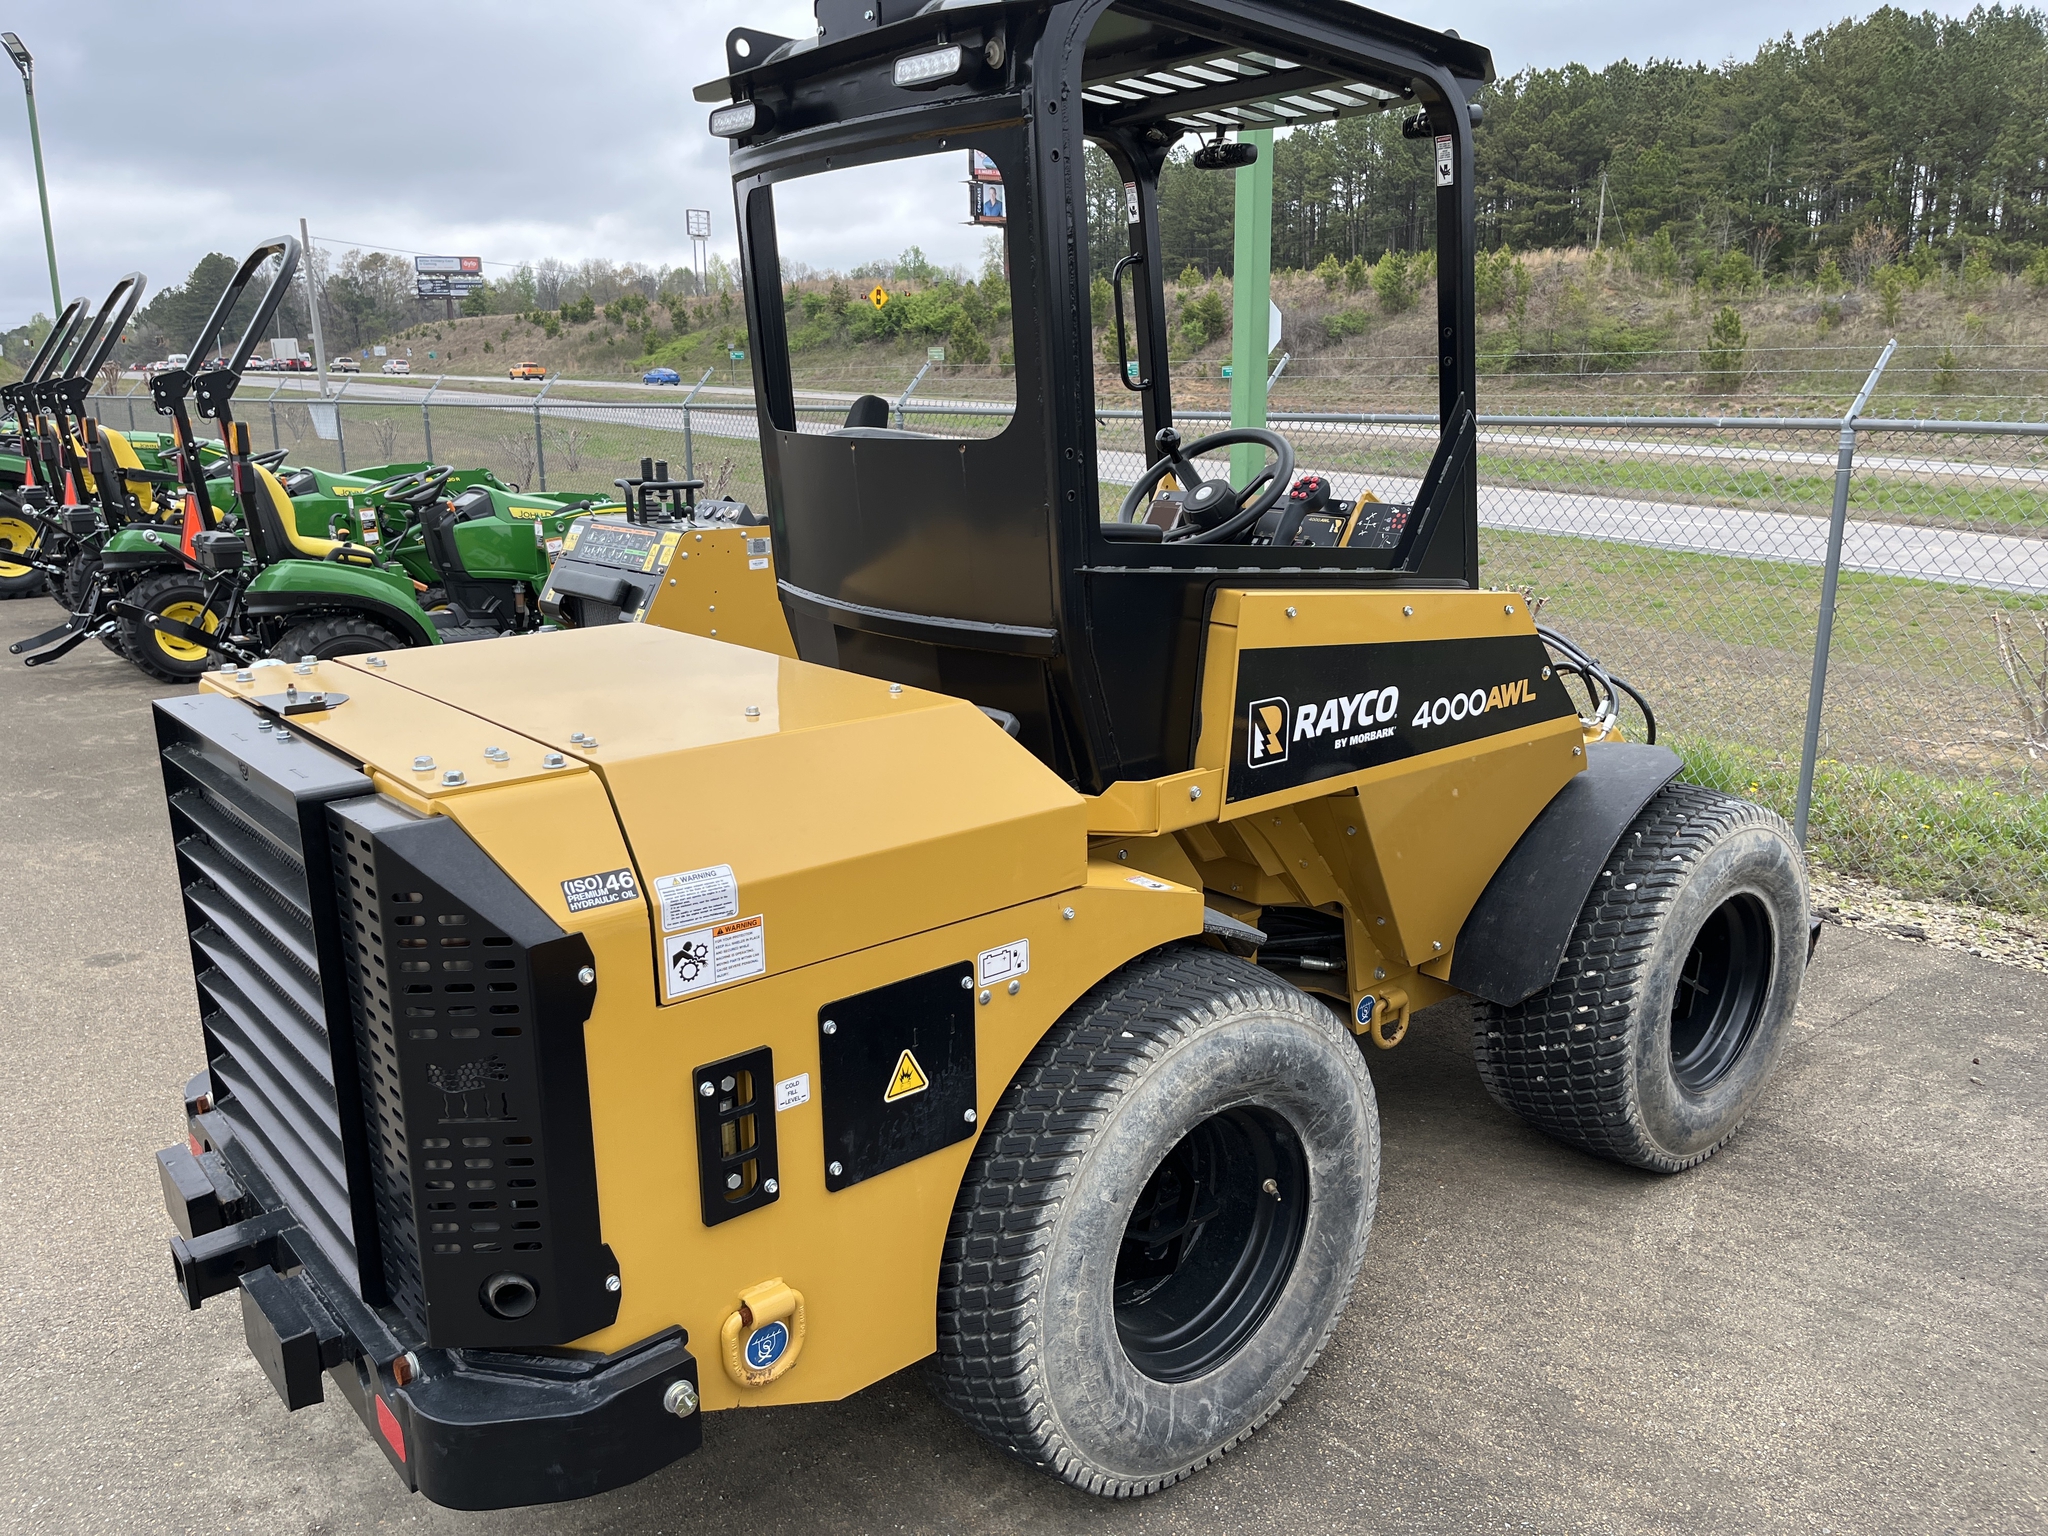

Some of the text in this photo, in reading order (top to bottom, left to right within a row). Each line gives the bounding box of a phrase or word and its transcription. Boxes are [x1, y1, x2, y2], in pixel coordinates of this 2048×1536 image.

[1293, 679, 1536, 742] RAYCO 4000AWL
[1334, 727, 1394, 749] BY MORBARK
[564, 871, 634, 895] (ISO) 46
[680, 870, 717, 882] WARNING
[567, 888, 609, 903] PREMIUM
[570, 890, 636, 911] HYDRAULIC OIL
[725, 920, 757, 932] WARNING
[785, 1080, 799, 1090] COLD
